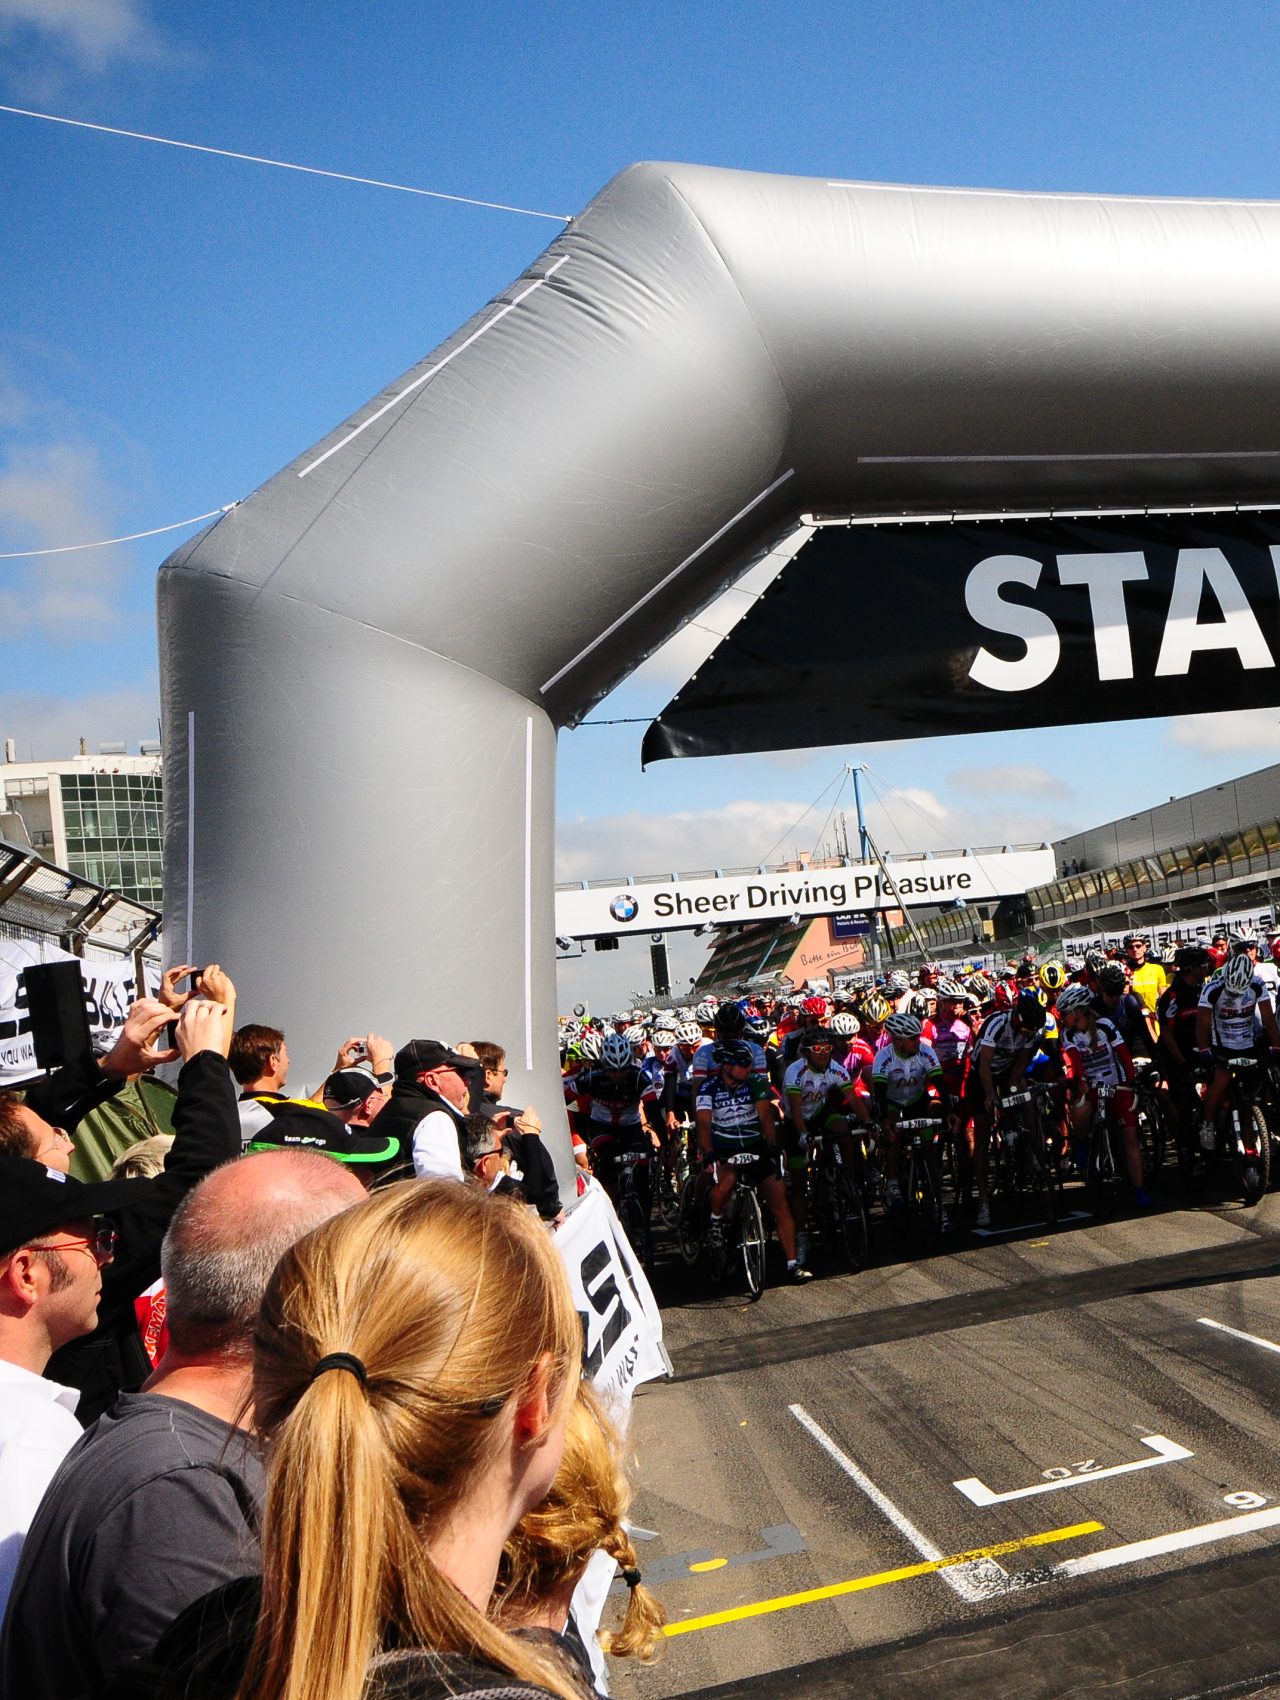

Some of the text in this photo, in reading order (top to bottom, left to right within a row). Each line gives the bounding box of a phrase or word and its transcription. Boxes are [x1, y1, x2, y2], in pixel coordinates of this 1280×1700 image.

[652, 872, 972, 918] Sheer Driving Pleasure
[0, 1047, 35, 1065] YOU WA
